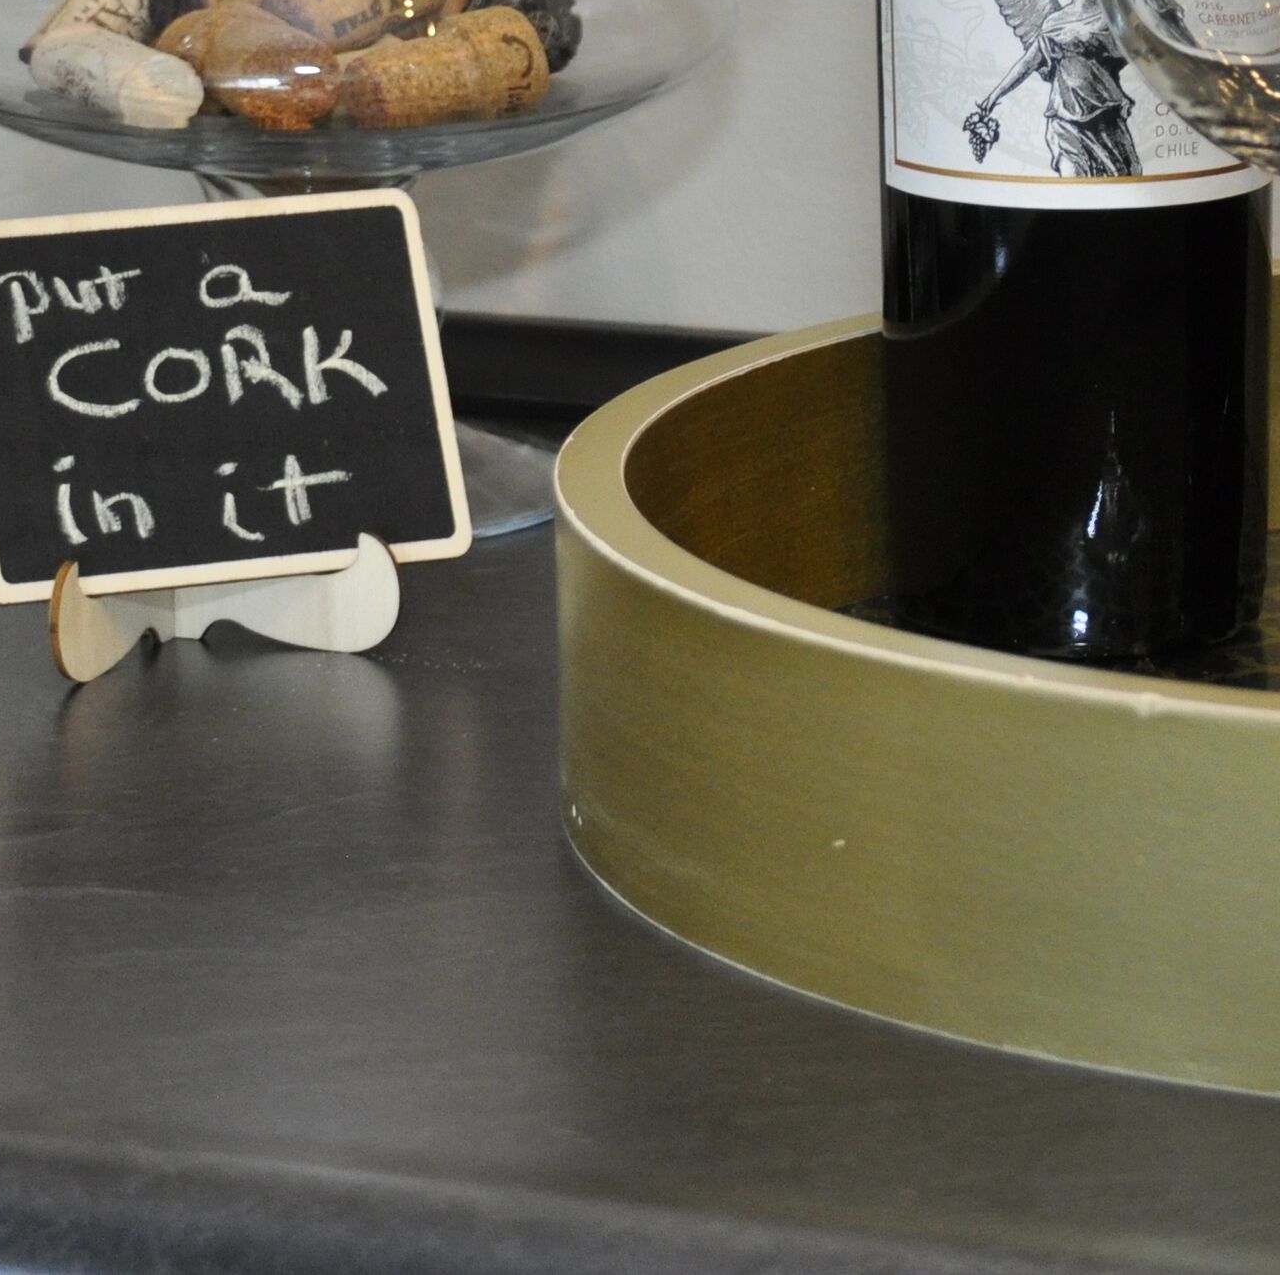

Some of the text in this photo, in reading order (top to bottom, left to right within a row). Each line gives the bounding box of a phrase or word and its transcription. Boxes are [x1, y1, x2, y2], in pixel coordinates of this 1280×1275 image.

[1155, 141, 1200, 158] CHILE
[47, 324, 388, 418] CORK
[53, 453, 353, 545] in it
